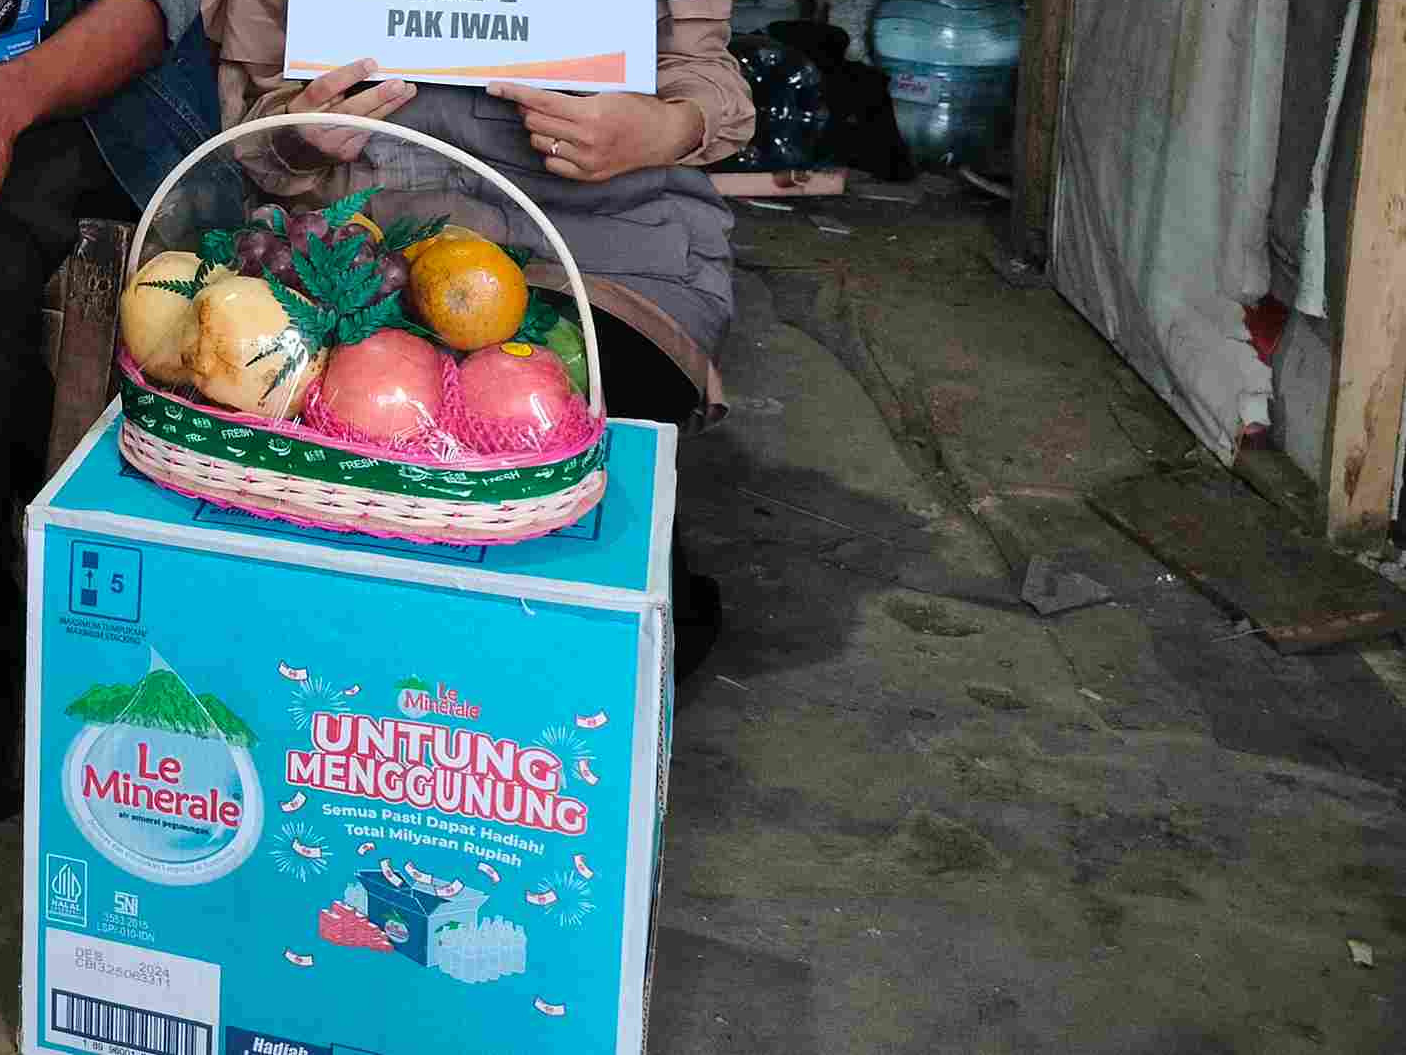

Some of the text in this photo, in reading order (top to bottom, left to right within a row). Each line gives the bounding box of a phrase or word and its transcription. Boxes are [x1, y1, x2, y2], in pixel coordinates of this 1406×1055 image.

[387, 9, 529, 43] PAK IWAN
[221, 427, 255, 441] FRESH
[338, 457, 379, 471] FRESH
[110, 573, 125, 594] 5
[404, 690, 481, 721] Minerale
[437, 681, 459, 703] Le
[137, 741, 182, 784] Le
[313, 713, 562, 793] UNTUNG
[83, 764, 242, 827] Minerale
[286, 750, 587, 835] MENGGUNUNG
[322, 803, 545, 856] Semua Pasti Dapat Hadiah!
[344, 823, 523, 868] Total Milyaran Rupiah
[51, 898, 81, 912] HALAL
[114, 891, 138, 916] SNI
[138, 961, 171, 978] 2024
